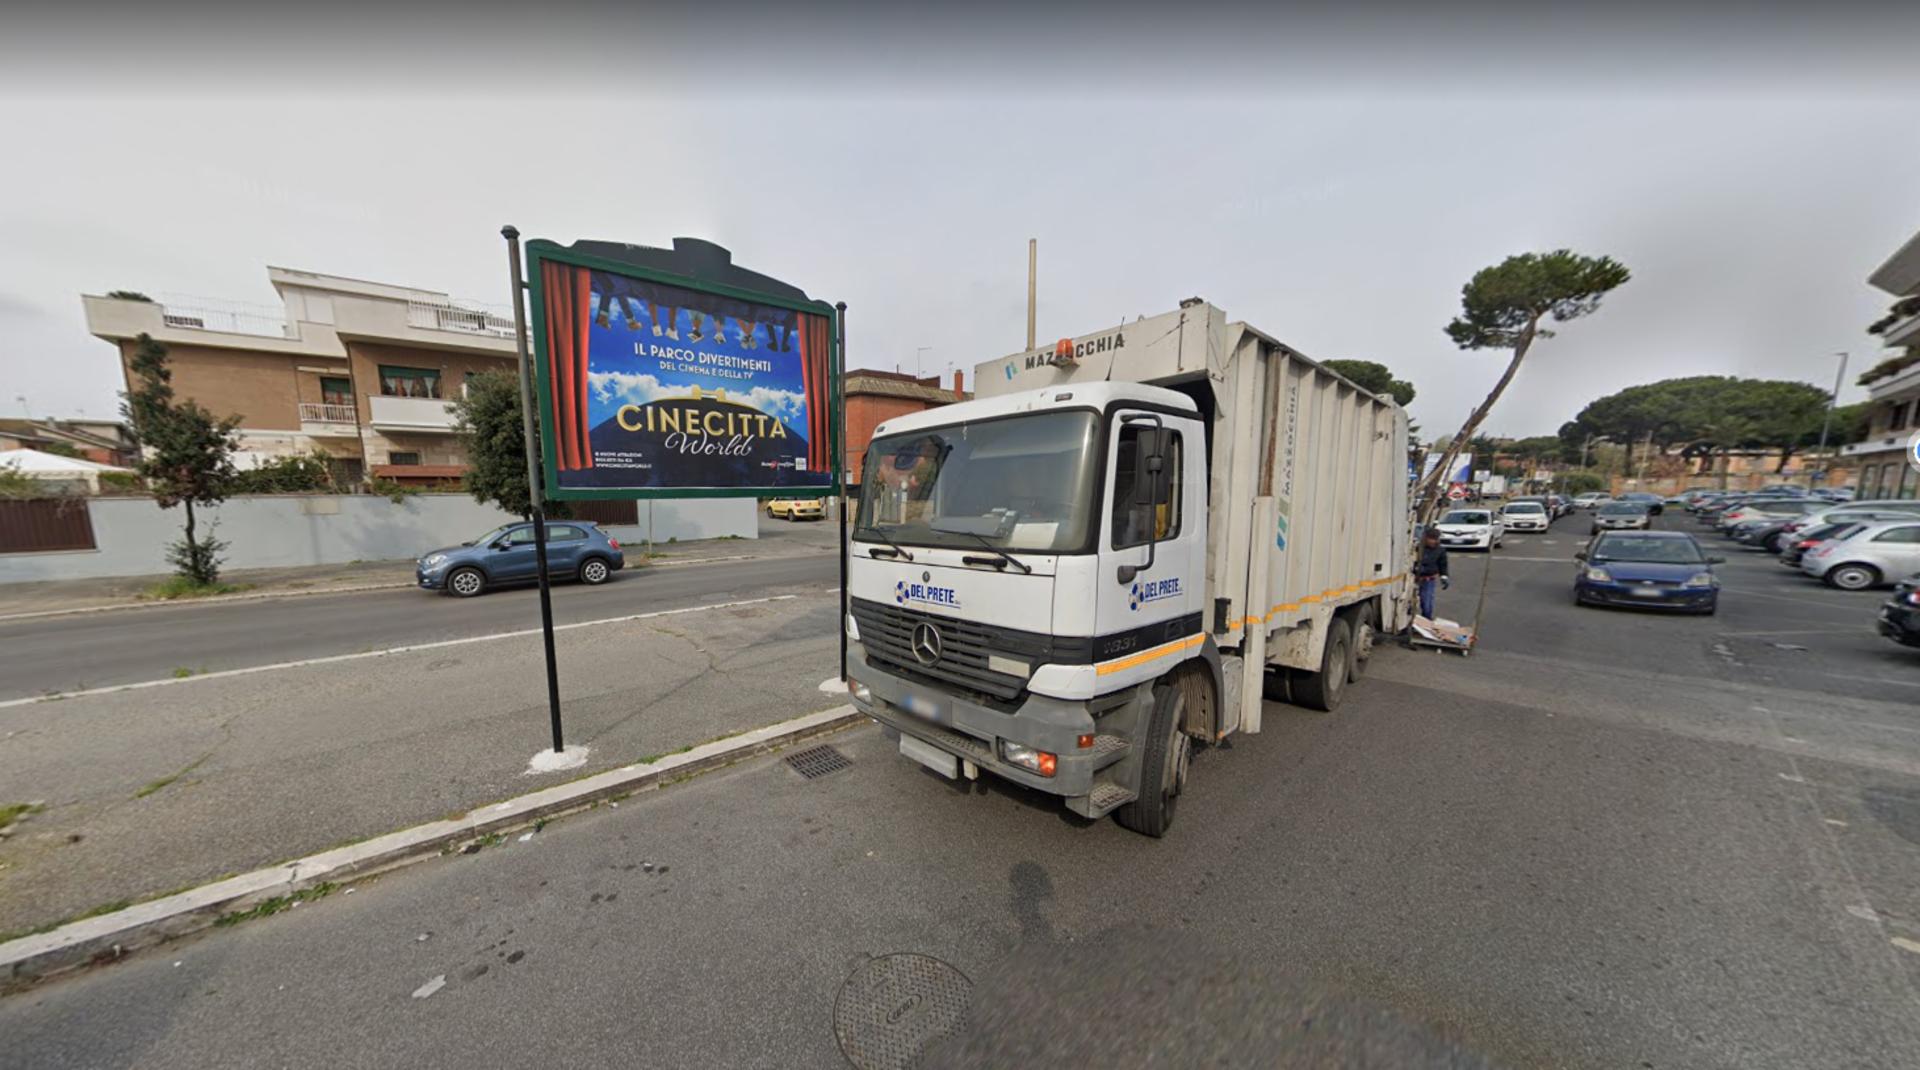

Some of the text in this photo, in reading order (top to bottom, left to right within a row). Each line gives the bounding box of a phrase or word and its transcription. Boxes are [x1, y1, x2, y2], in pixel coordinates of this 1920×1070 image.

[634, 342, 771, 372] IL PARCO DIVERTIMENTI
[1025, 333, 1125, 370] MAZCCHIA
[659, 360, 754, 380] DEL CINEMA E DELLA TV
[664, 427, 755, 456] World
[911, 584, 954, 604] DEL PRETE
[1145, 578, 1179, 598] DEL PRETE
